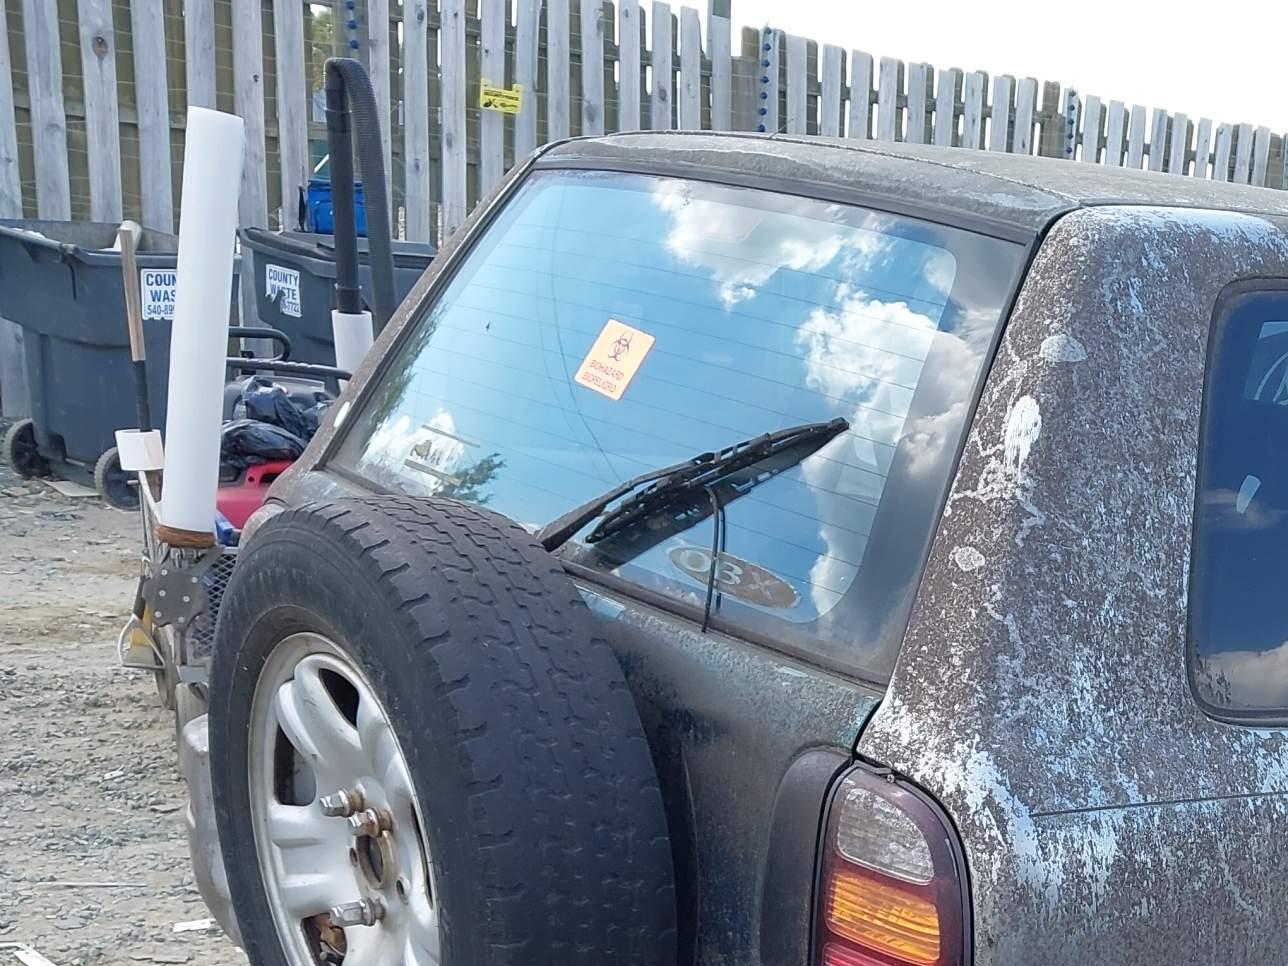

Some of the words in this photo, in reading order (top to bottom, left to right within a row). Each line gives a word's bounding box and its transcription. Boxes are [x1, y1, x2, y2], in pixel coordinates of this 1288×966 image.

[269, 268, 299, 287] COUNTY
[147, 304, 176, 315] 540-89
[679, 549, 781, 602] OBX
